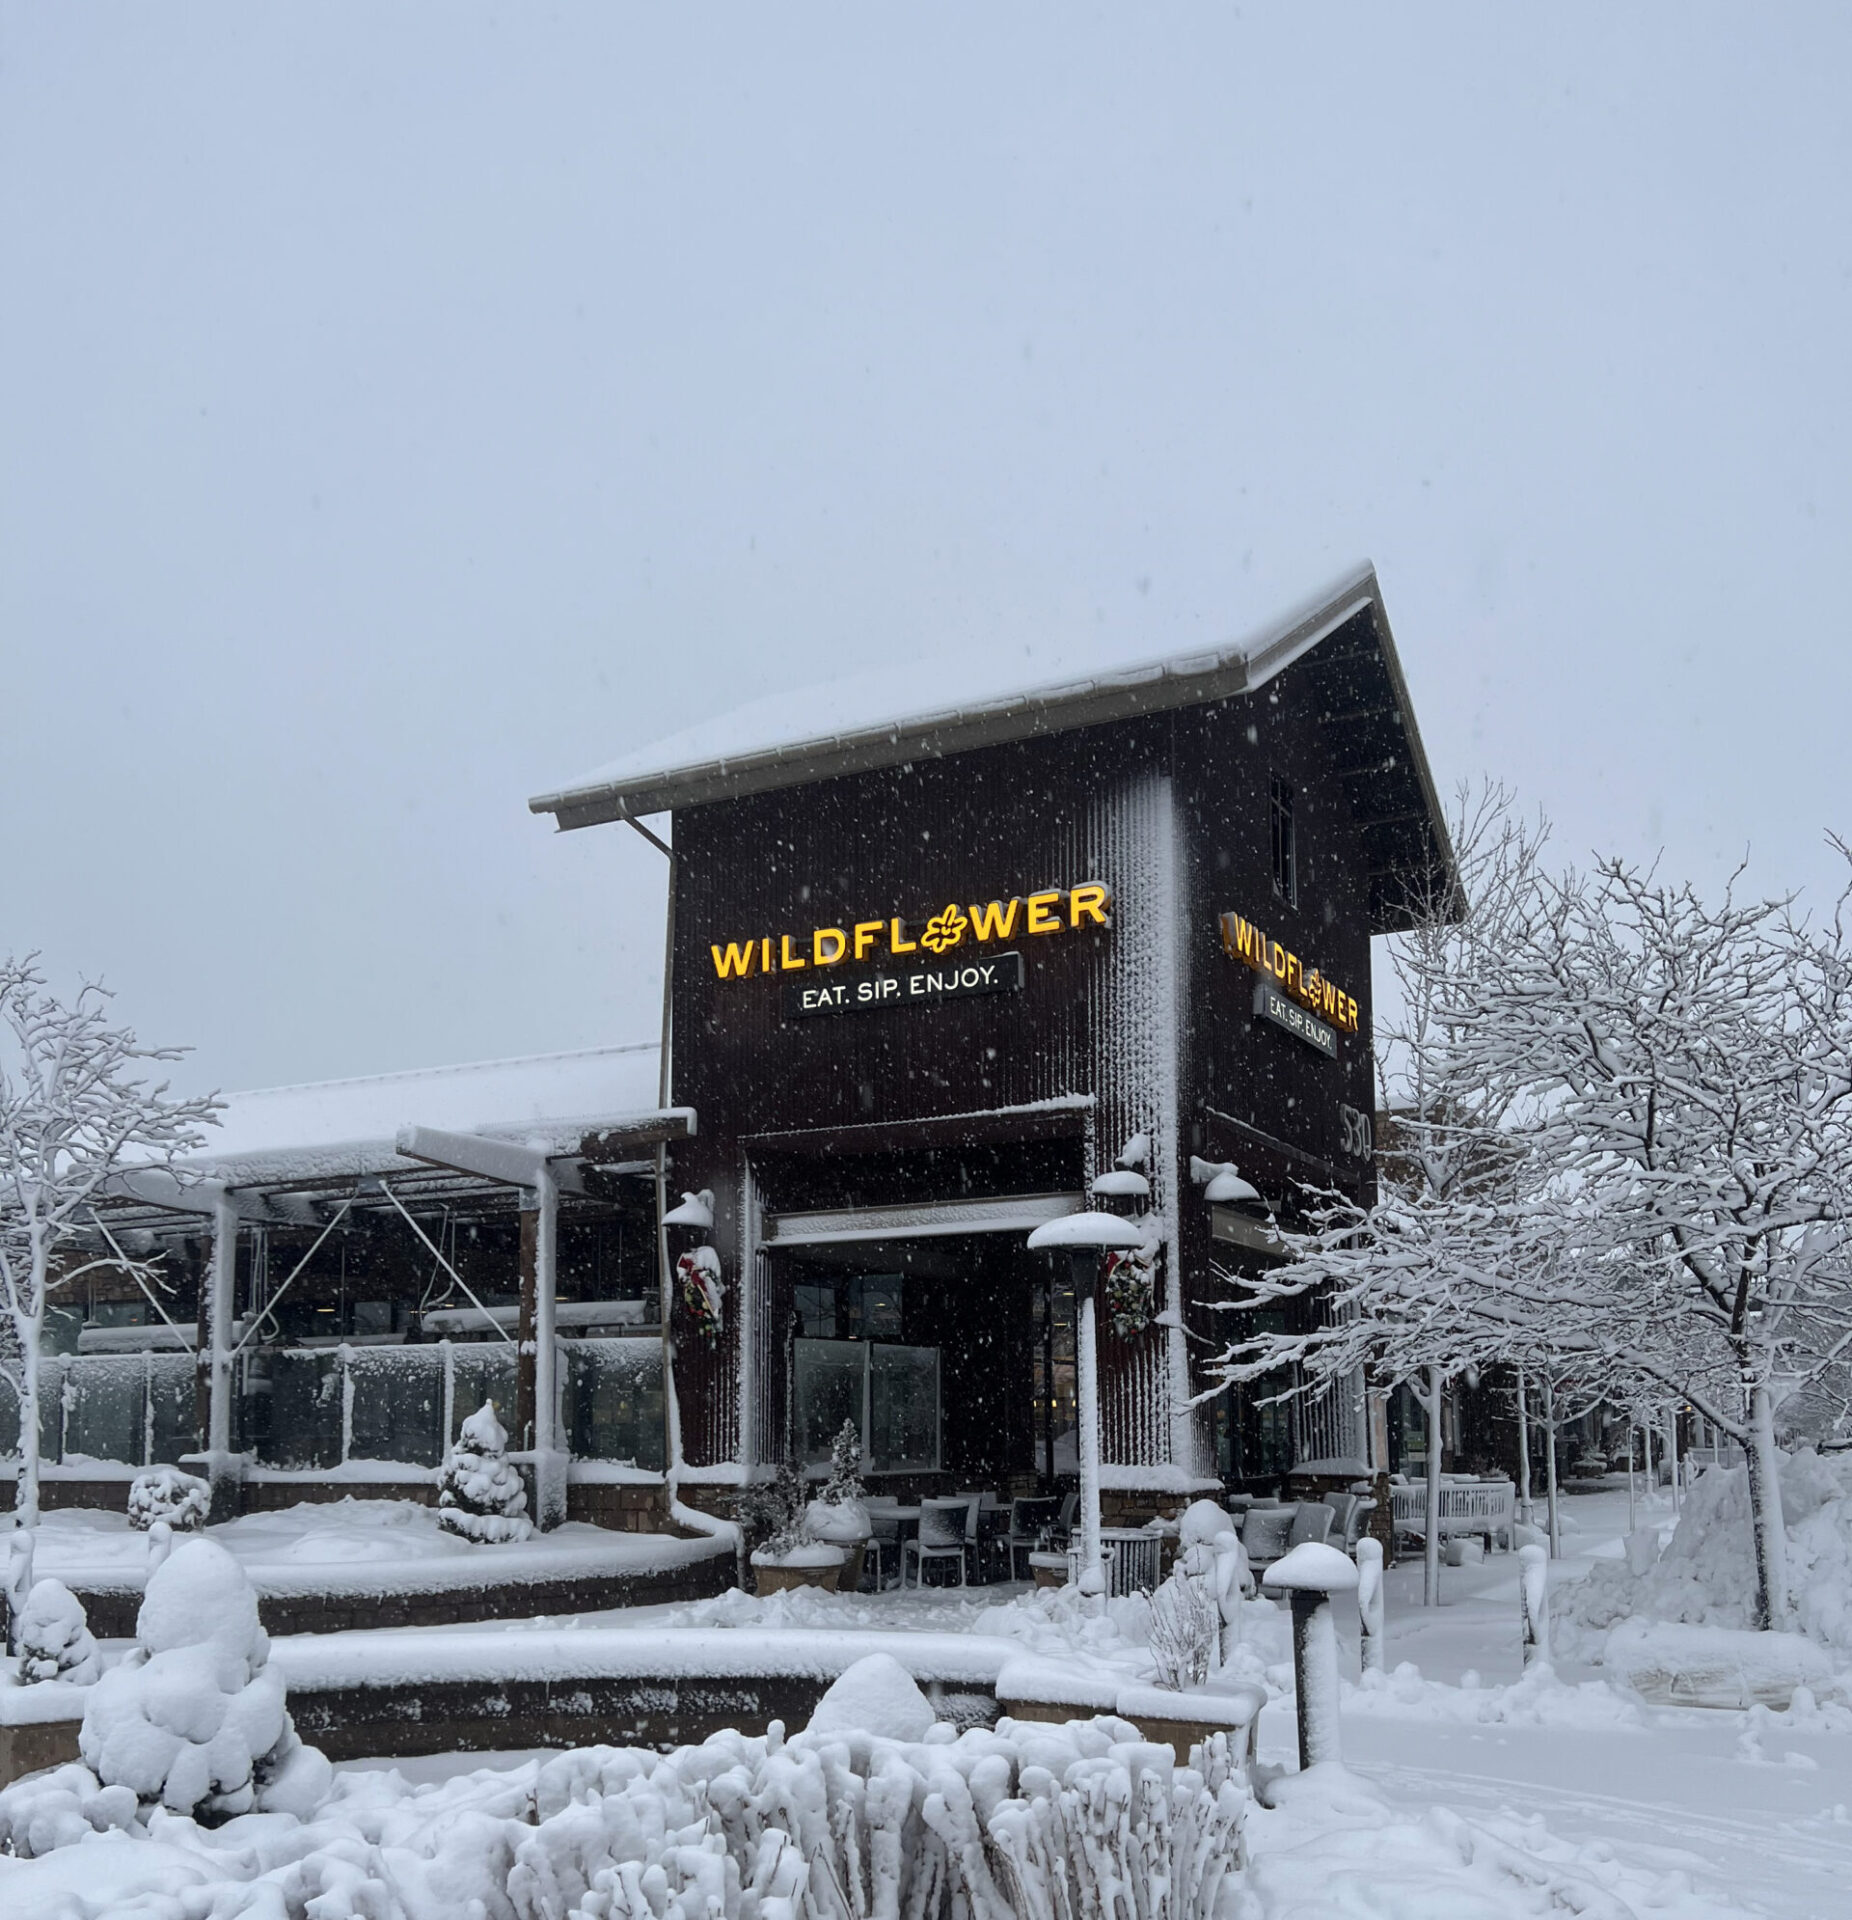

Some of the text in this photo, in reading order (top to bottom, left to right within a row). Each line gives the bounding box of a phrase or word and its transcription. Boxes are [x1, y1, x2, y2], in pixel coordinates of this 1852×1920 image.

[803, 965, 999, 1009] EAT. SIP. ENJOY.
[1270, 996, 1333, 1050] EAT. SIP. ENJOY.
